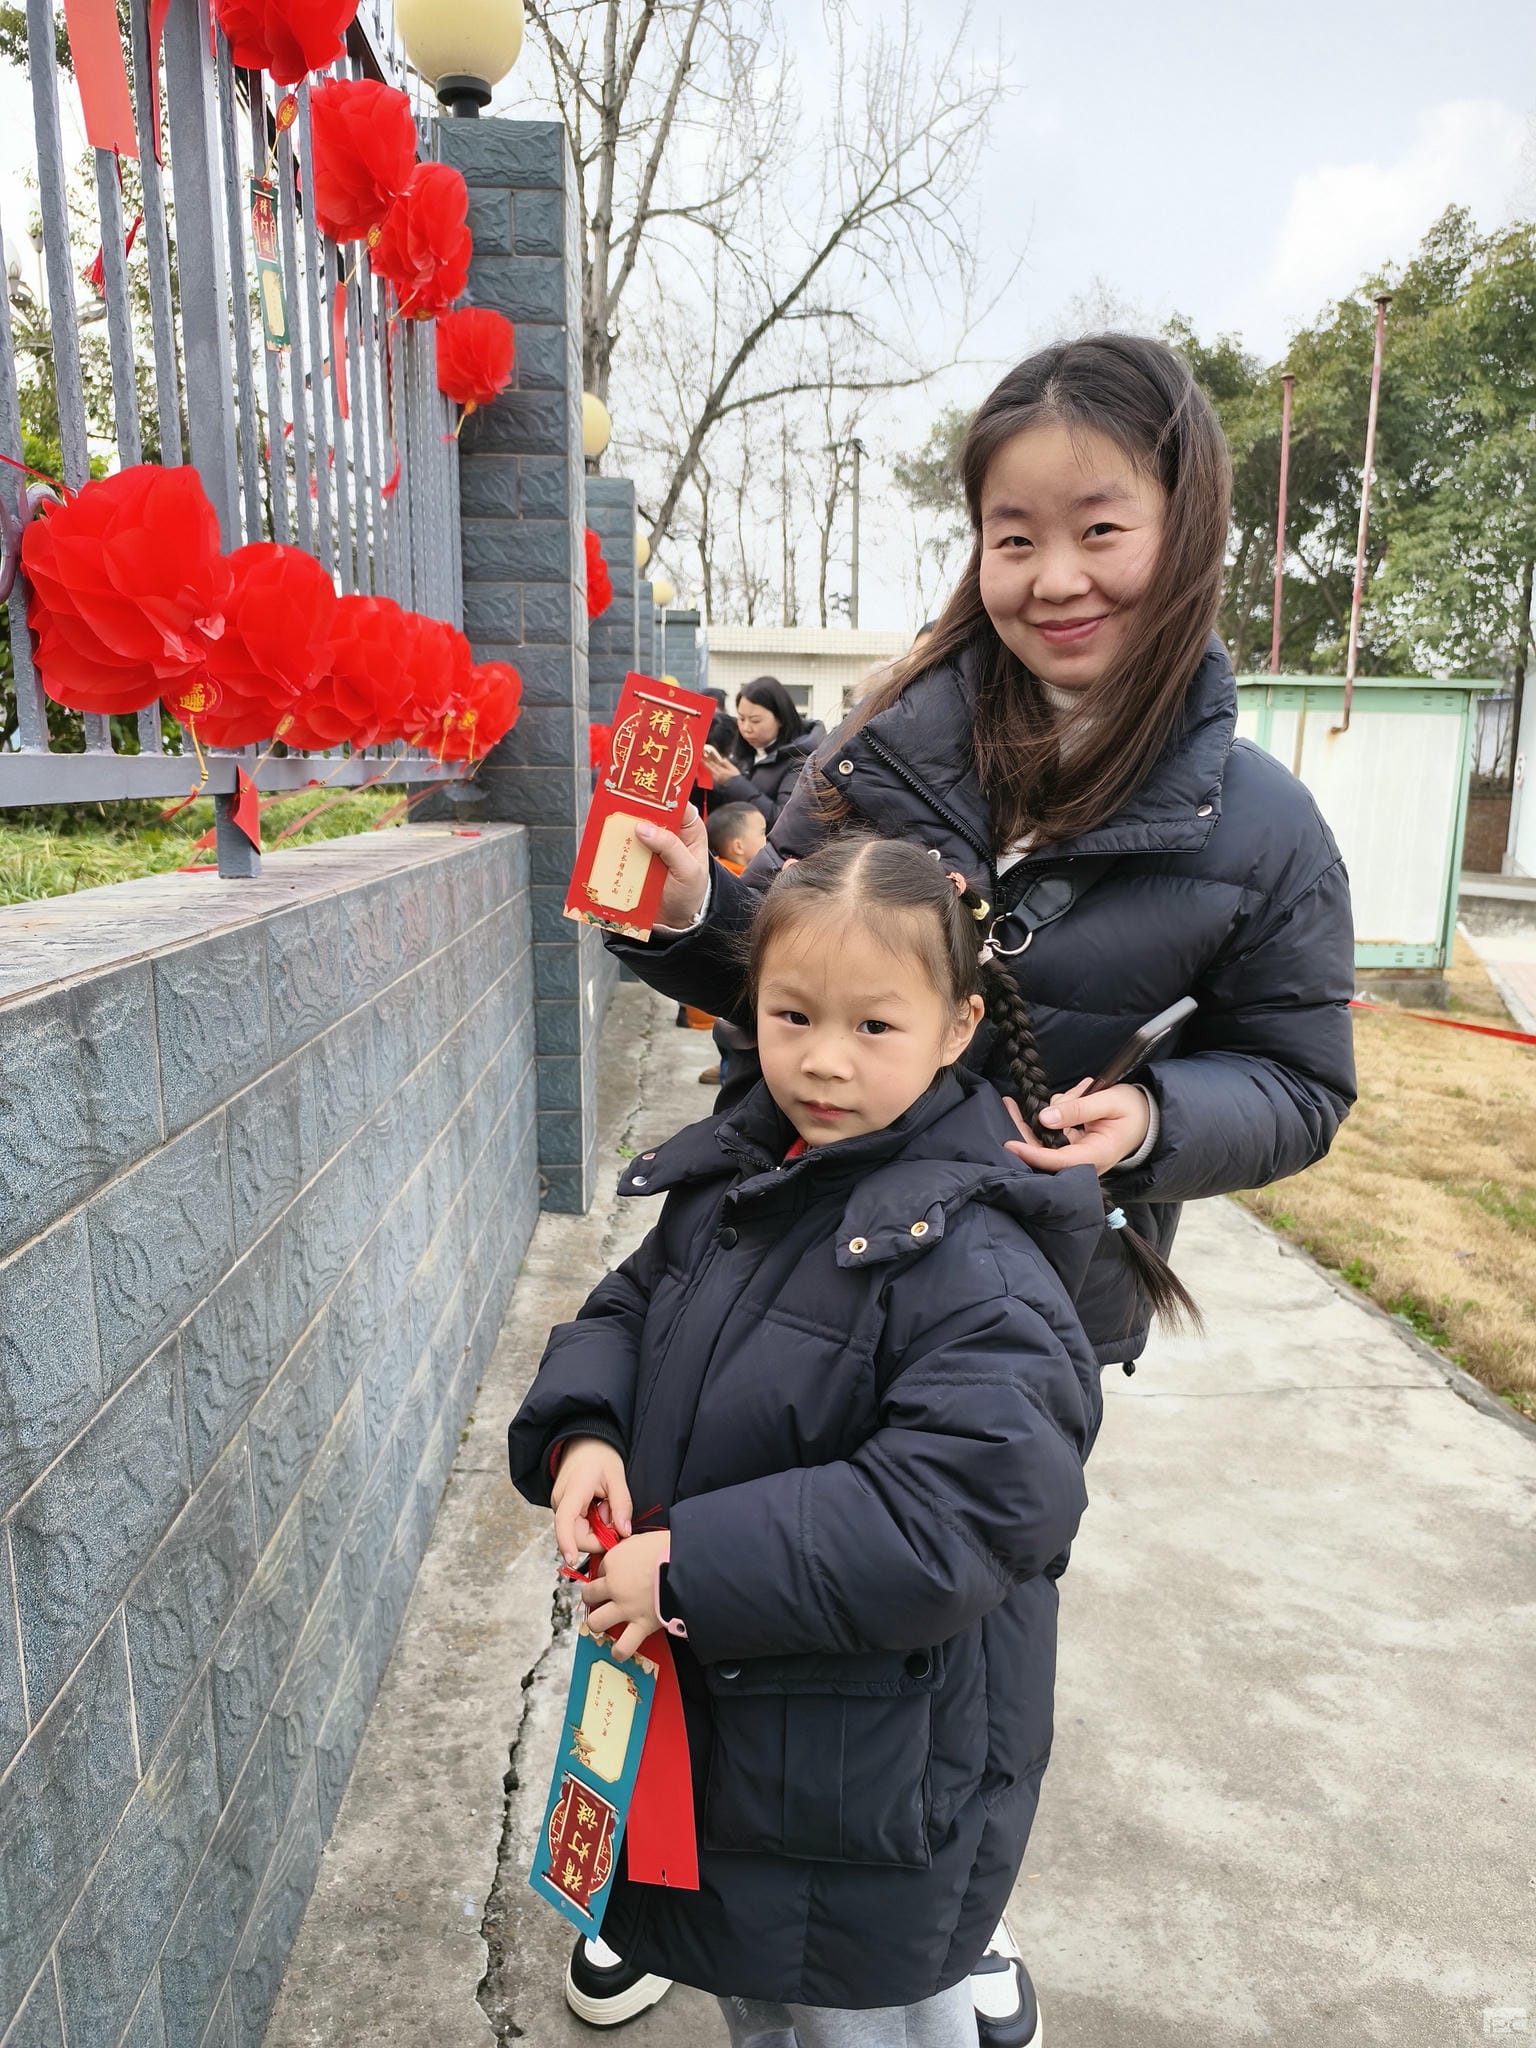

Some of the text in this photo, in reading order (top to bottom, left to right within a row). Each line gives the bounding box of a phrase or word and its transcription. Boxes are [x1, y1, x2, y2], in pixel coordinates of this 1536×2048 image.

[631, 708, 676, 794] 猜灯谜
[562, 1796, 598, 1893] 猜灯谜
